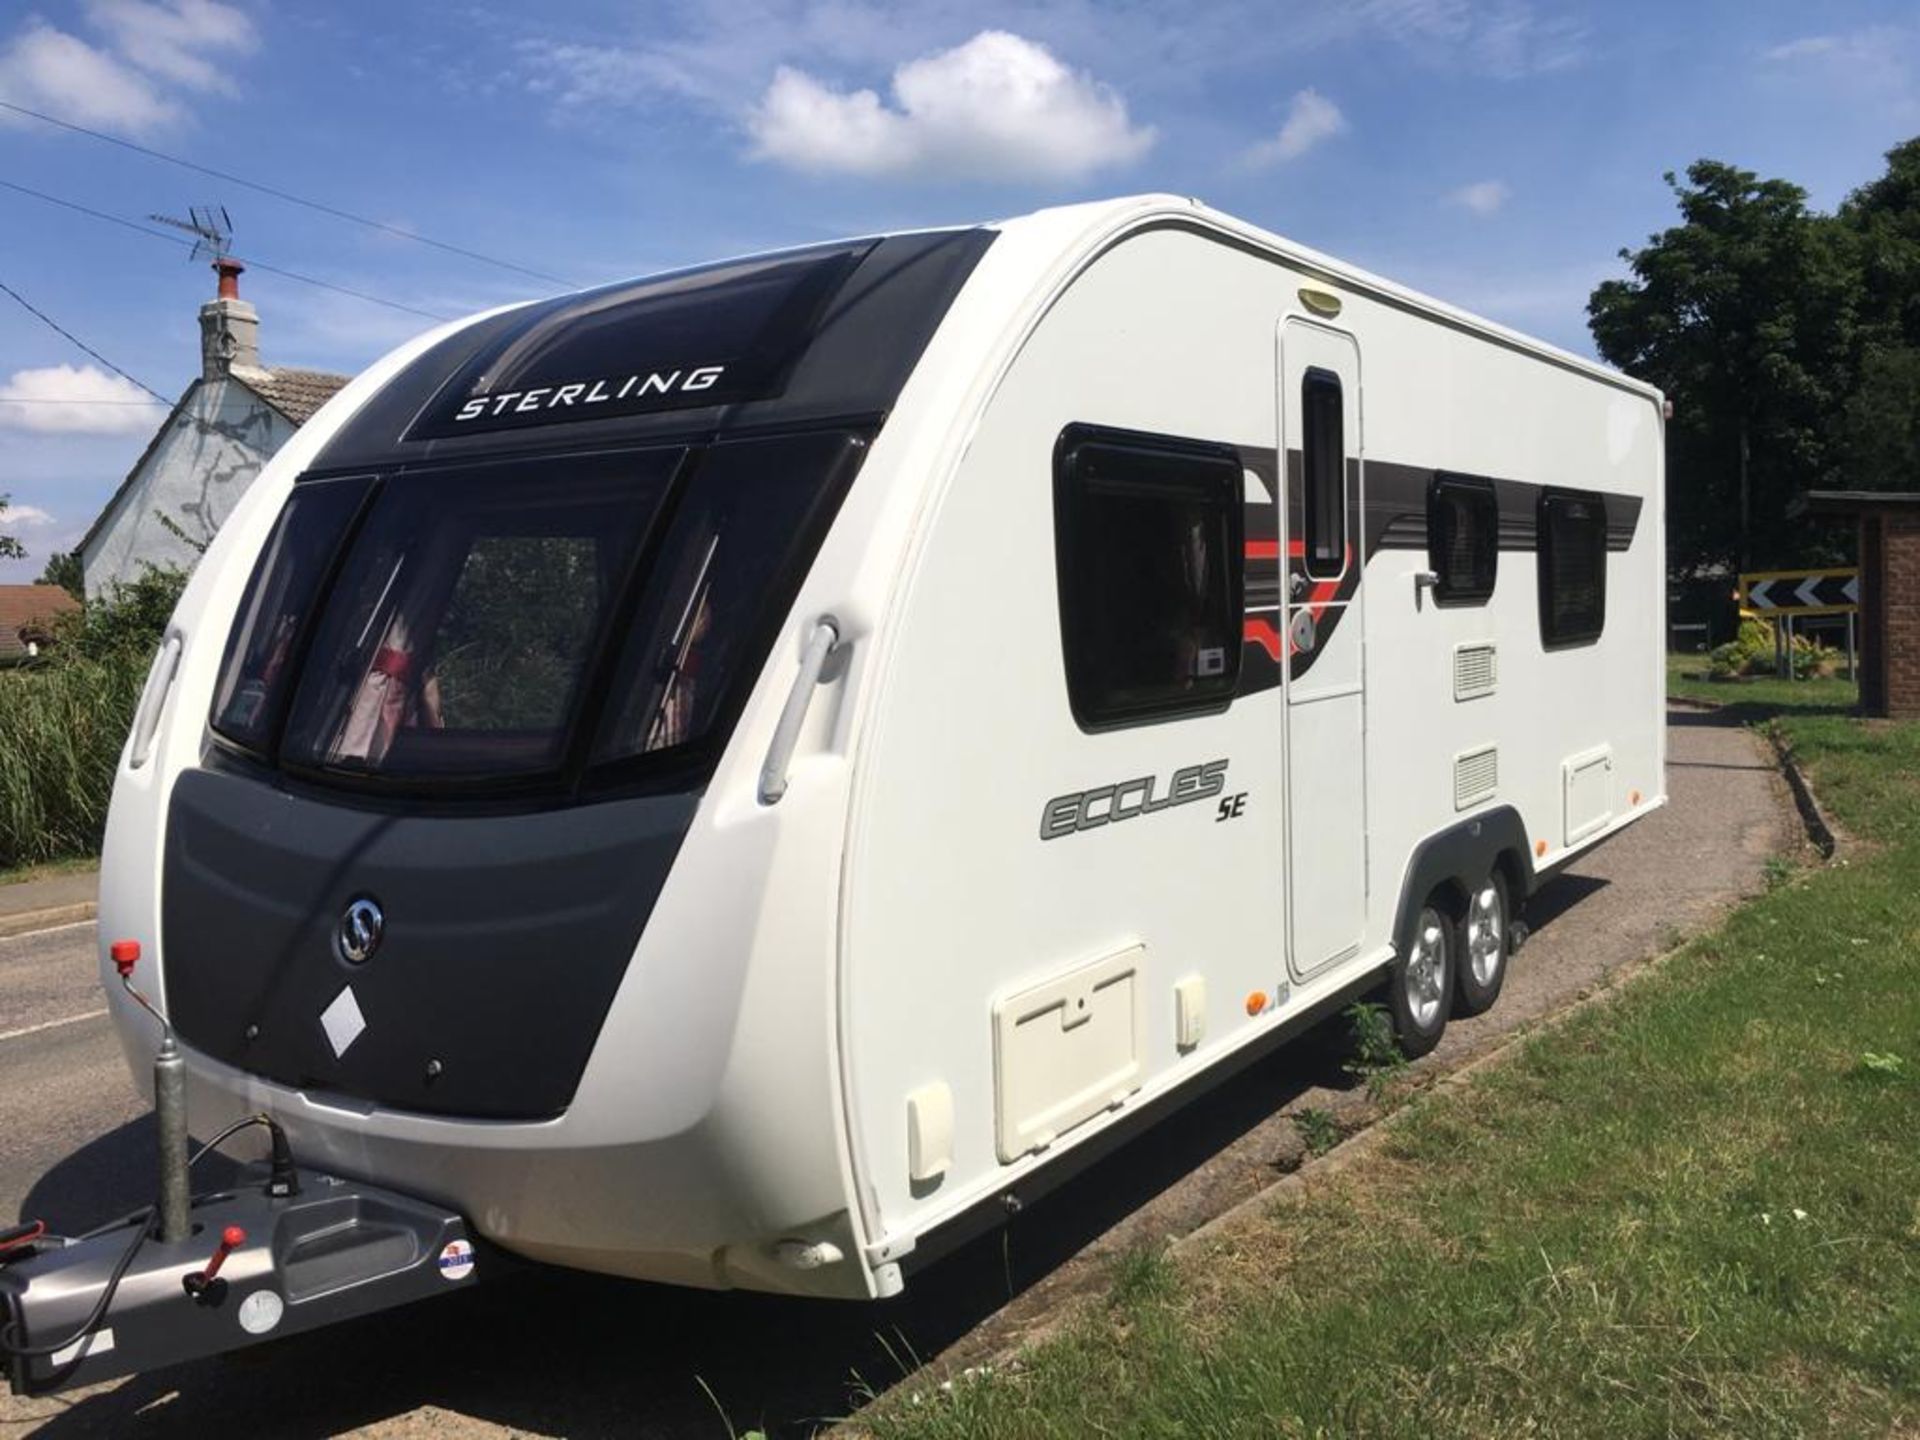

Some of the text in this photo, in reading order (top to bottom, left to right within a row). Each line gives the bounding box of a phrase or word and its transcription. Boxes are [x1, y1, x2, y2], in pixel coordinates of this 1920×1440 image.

[455, 366, 725, 421] STERLING
[1040, 758, 1249, 841] ECCLES SE
